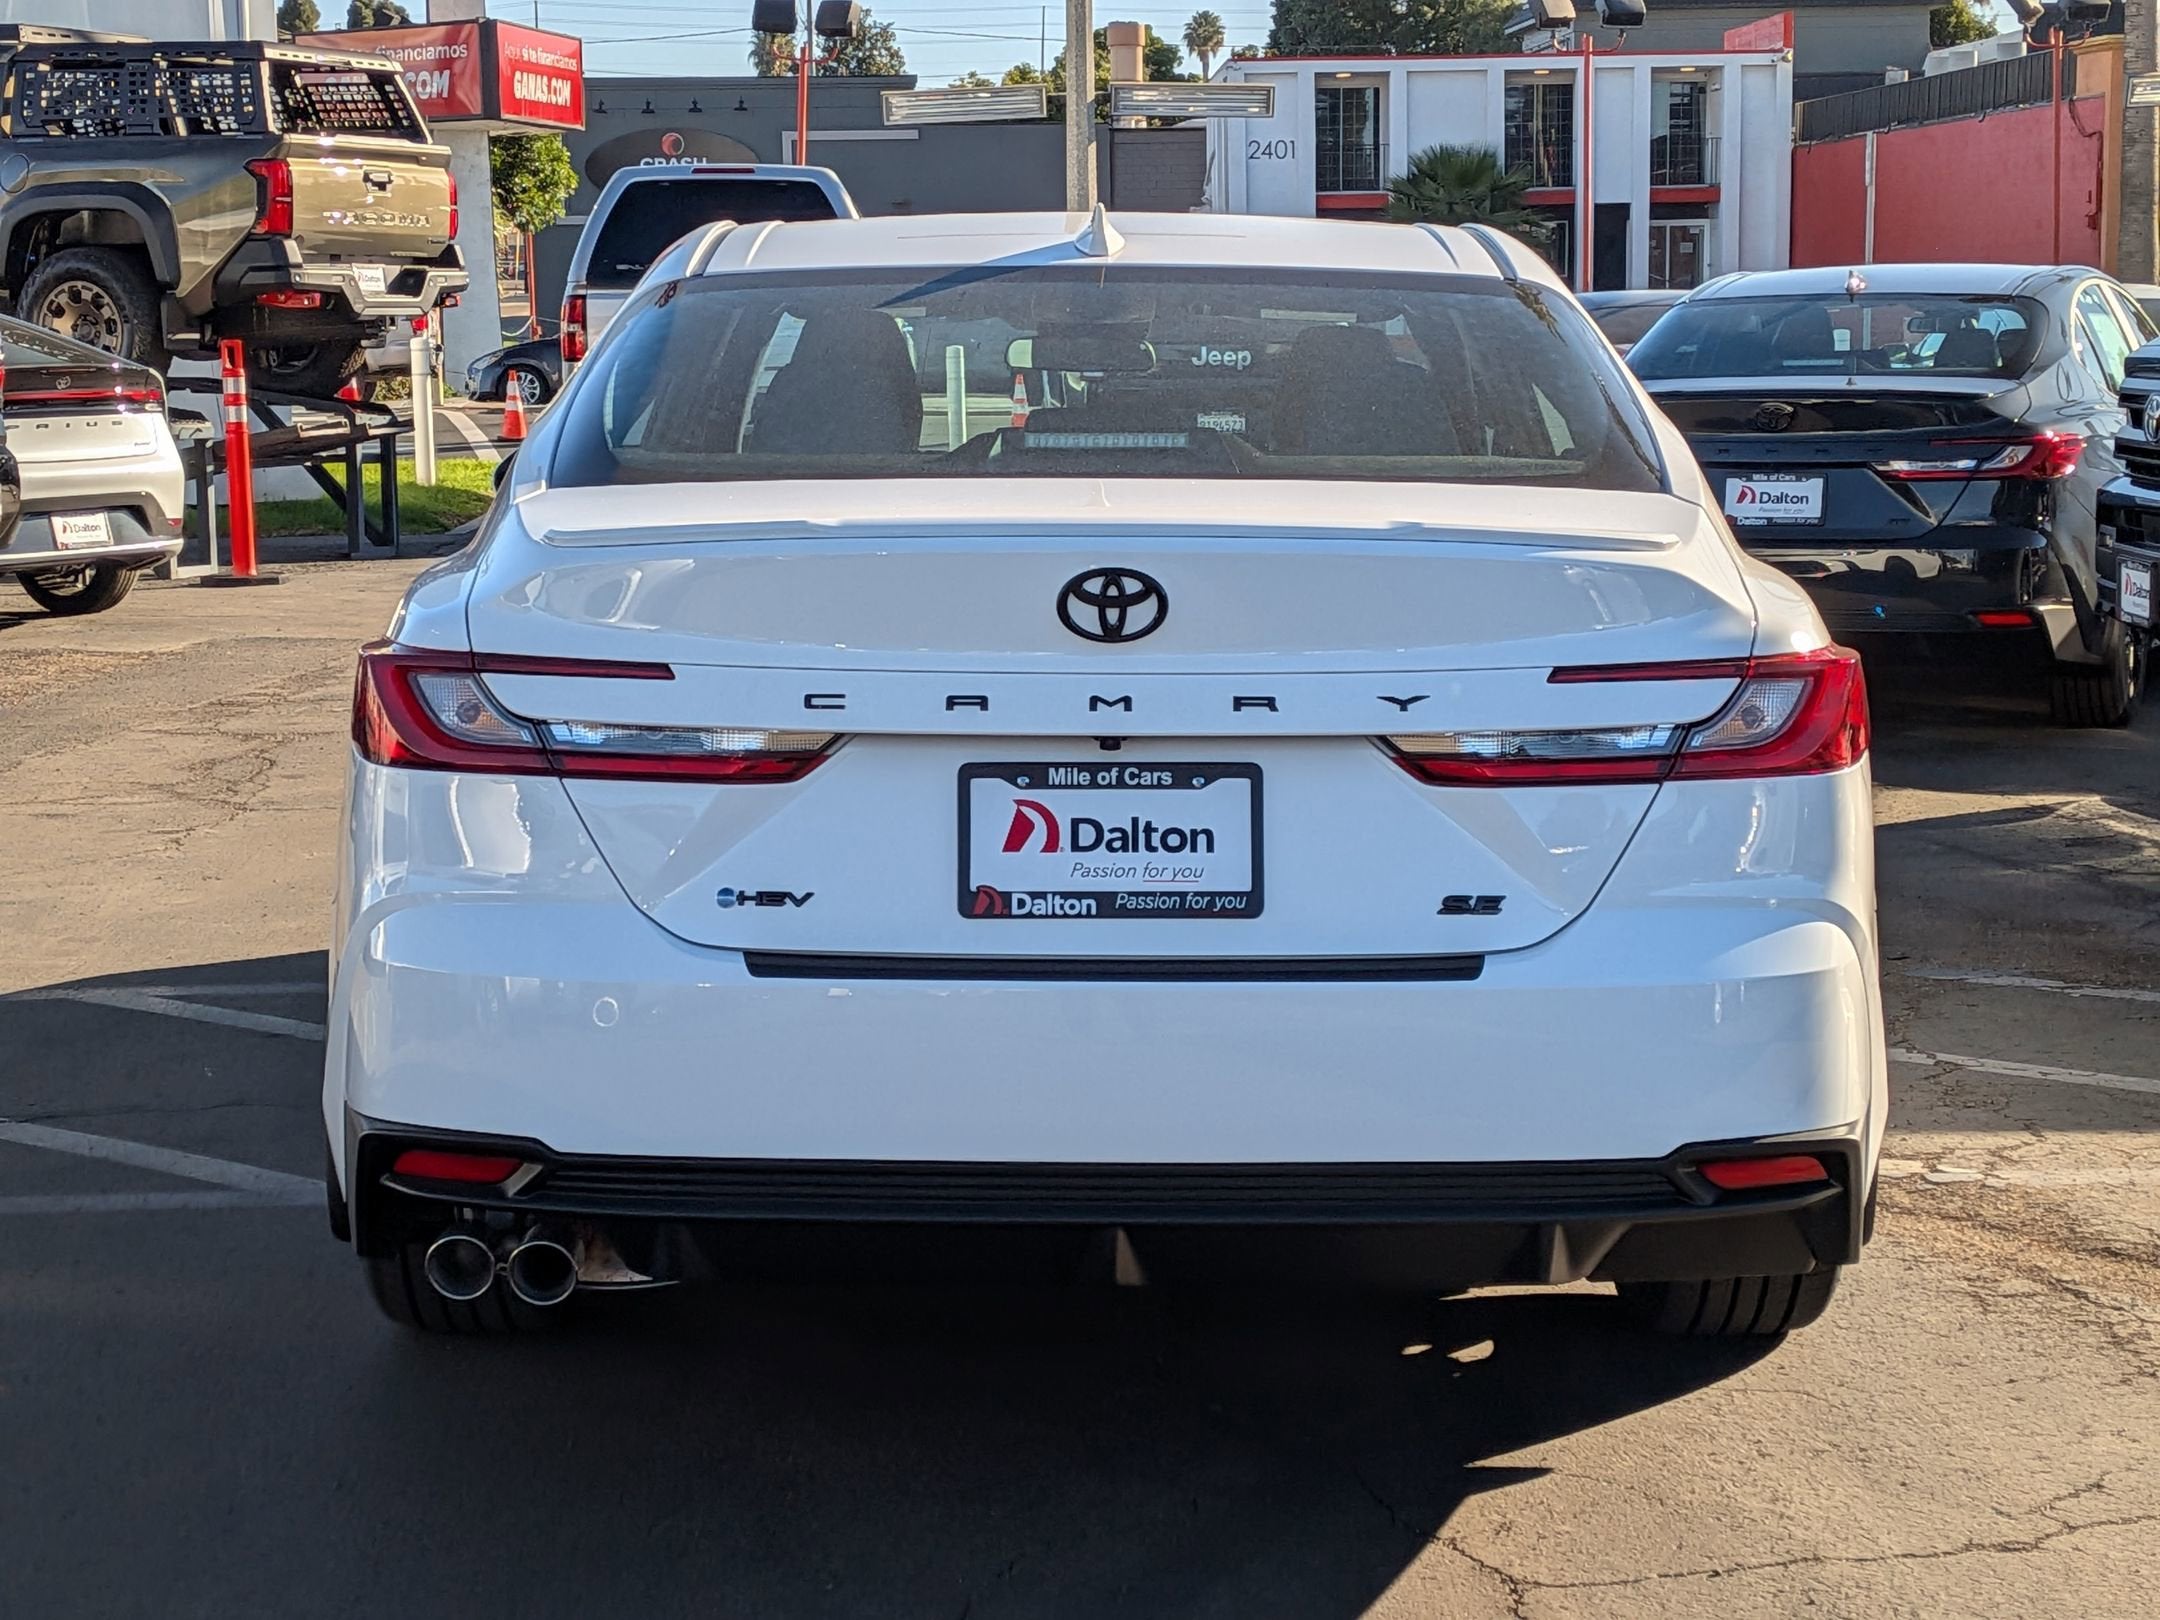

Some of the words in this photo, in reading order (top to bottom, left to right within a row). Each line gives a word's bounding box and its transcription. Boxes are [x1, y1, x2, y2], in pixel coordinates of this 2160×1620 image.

[513, 70, 571, 107] GANAS.COM
[1248, 139, 1295, 160] 2401
[1191, 346, 1251, 371] Jeep
[1759, 491, 1809, 505] Dalton
[804, 693, 1431, 713] CAMRY
[1048, 767, 1093, 786] Mile
[1096, 767, 1119, 786] of
[1124, 767, 1173, 786] Cars
[1070, 816, 1215, 854] Dalton
[1070, 862, 1137, 878] Passion
[1142, 861, 1169, 879] for
[1171, 865, 1205, 881] you
[736, 890, 815, 907] HEV
[1011, 893, 1097, 916] Dalton
[1115, 892, 1182, 910] Passion
[1185, 892, 1210, 911] for
[1212, 896, 1247, 913] you
[1437, 894, 1507, 915] SE
